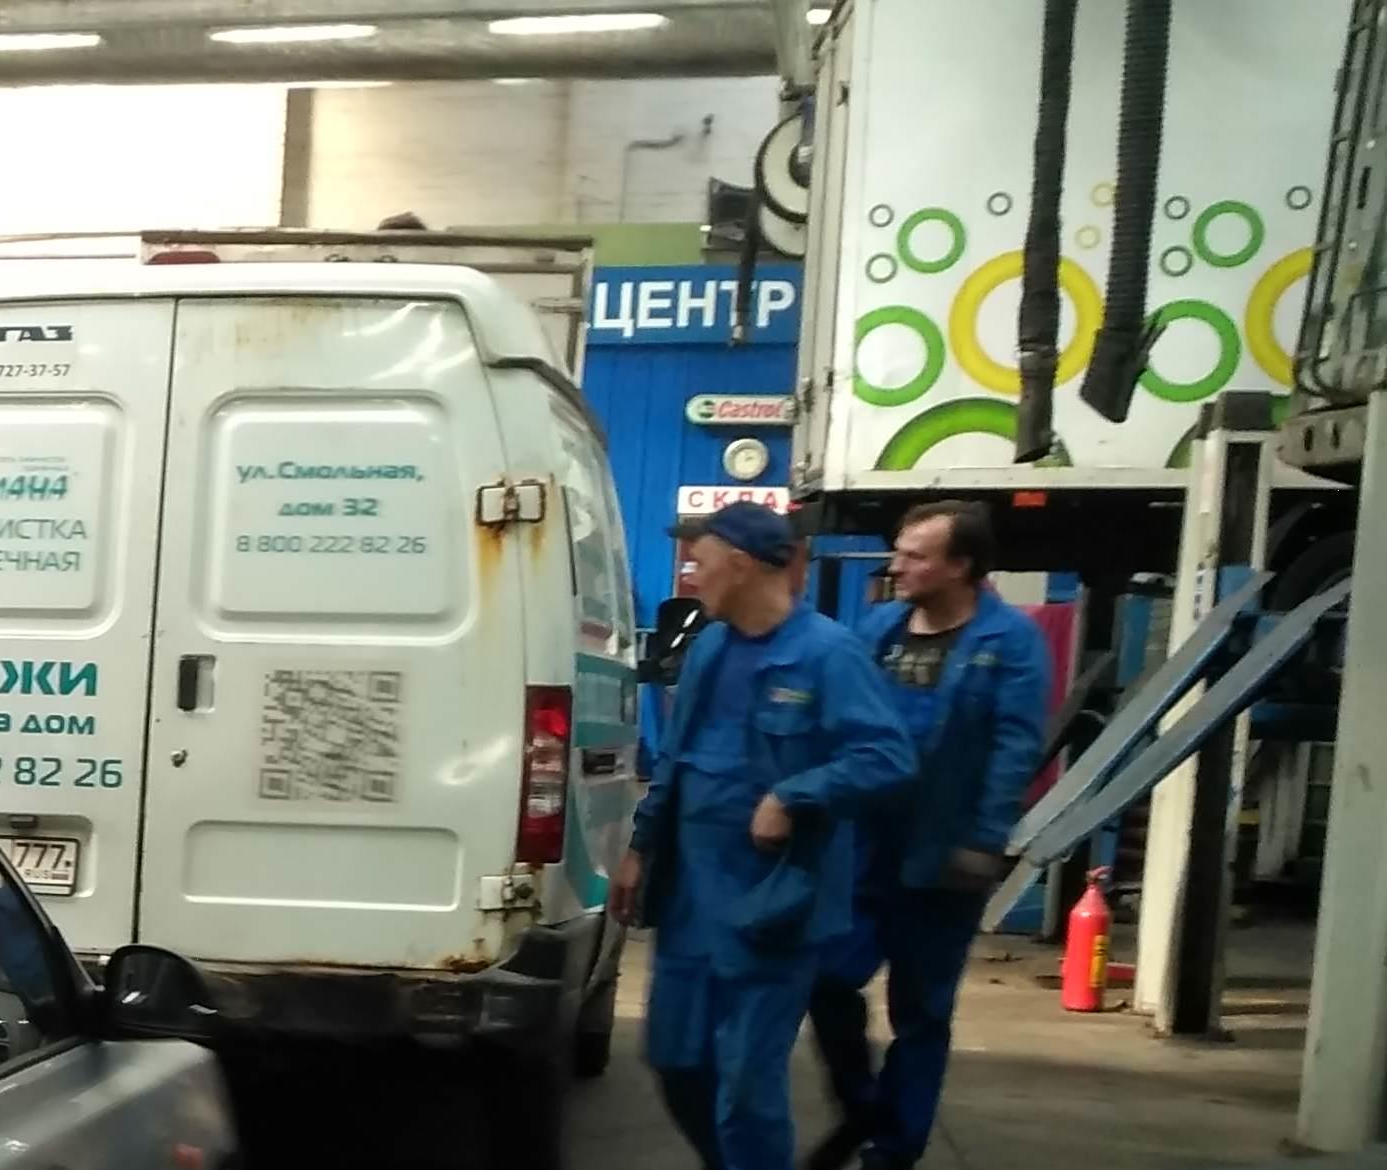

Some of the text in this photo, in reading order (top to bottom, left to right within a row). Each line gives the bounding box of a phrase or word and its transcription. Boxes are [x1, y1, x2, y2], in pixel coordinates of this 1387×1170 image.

[584, 280, 796, 338] ЦЕНТР
[278, 498, 379, 517] дом 32
[235, 534, 427, 554] 8 800 222 82 26
[20, 714, 96, 735] дом
[13, 756, 63, 787] 82
[73, 758, 124, 789] 26
[15, 842, 67, 870] 777
